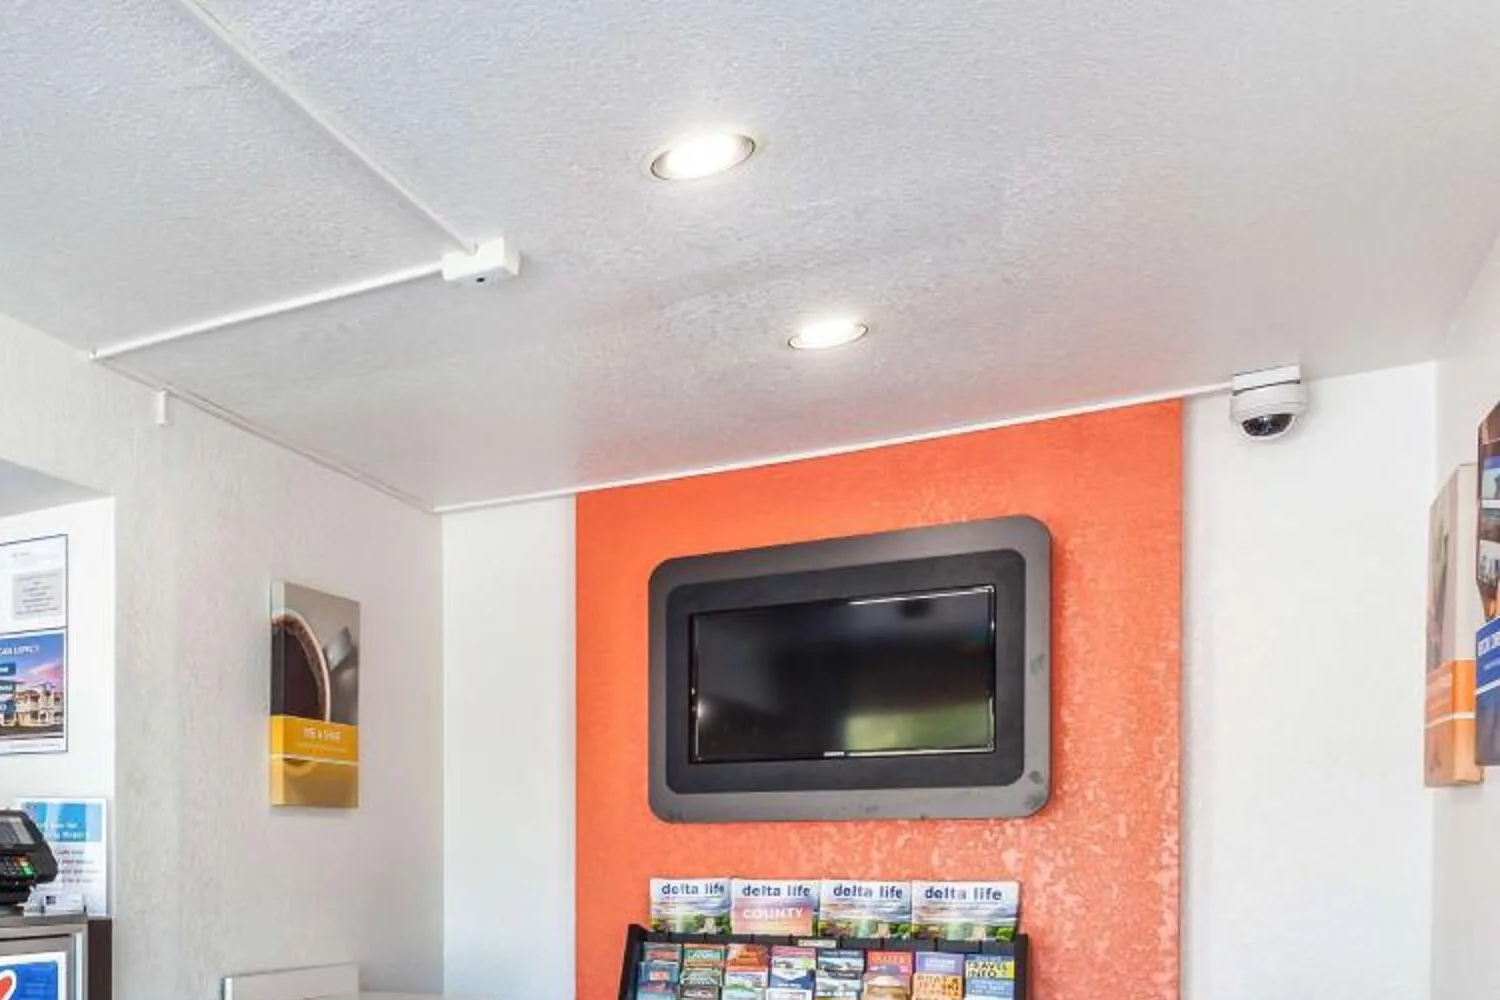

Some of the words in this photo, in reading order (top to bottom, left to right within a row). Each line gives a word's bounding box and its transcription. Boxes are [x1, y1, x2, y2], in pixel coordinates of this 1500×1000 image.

[661, 882, 699, 896] delta
[705, 882, 725, 895] life
[741, 884, 781, 897] delta
[787, 884, 811, 897] life
[832, 884, 873, 898] delta
[879, 885, 903, 899] life
[924, 885, 967, 900] delta
[973, 886, 1003, 901] life
[742, 907, 804, 920] COUNTY
